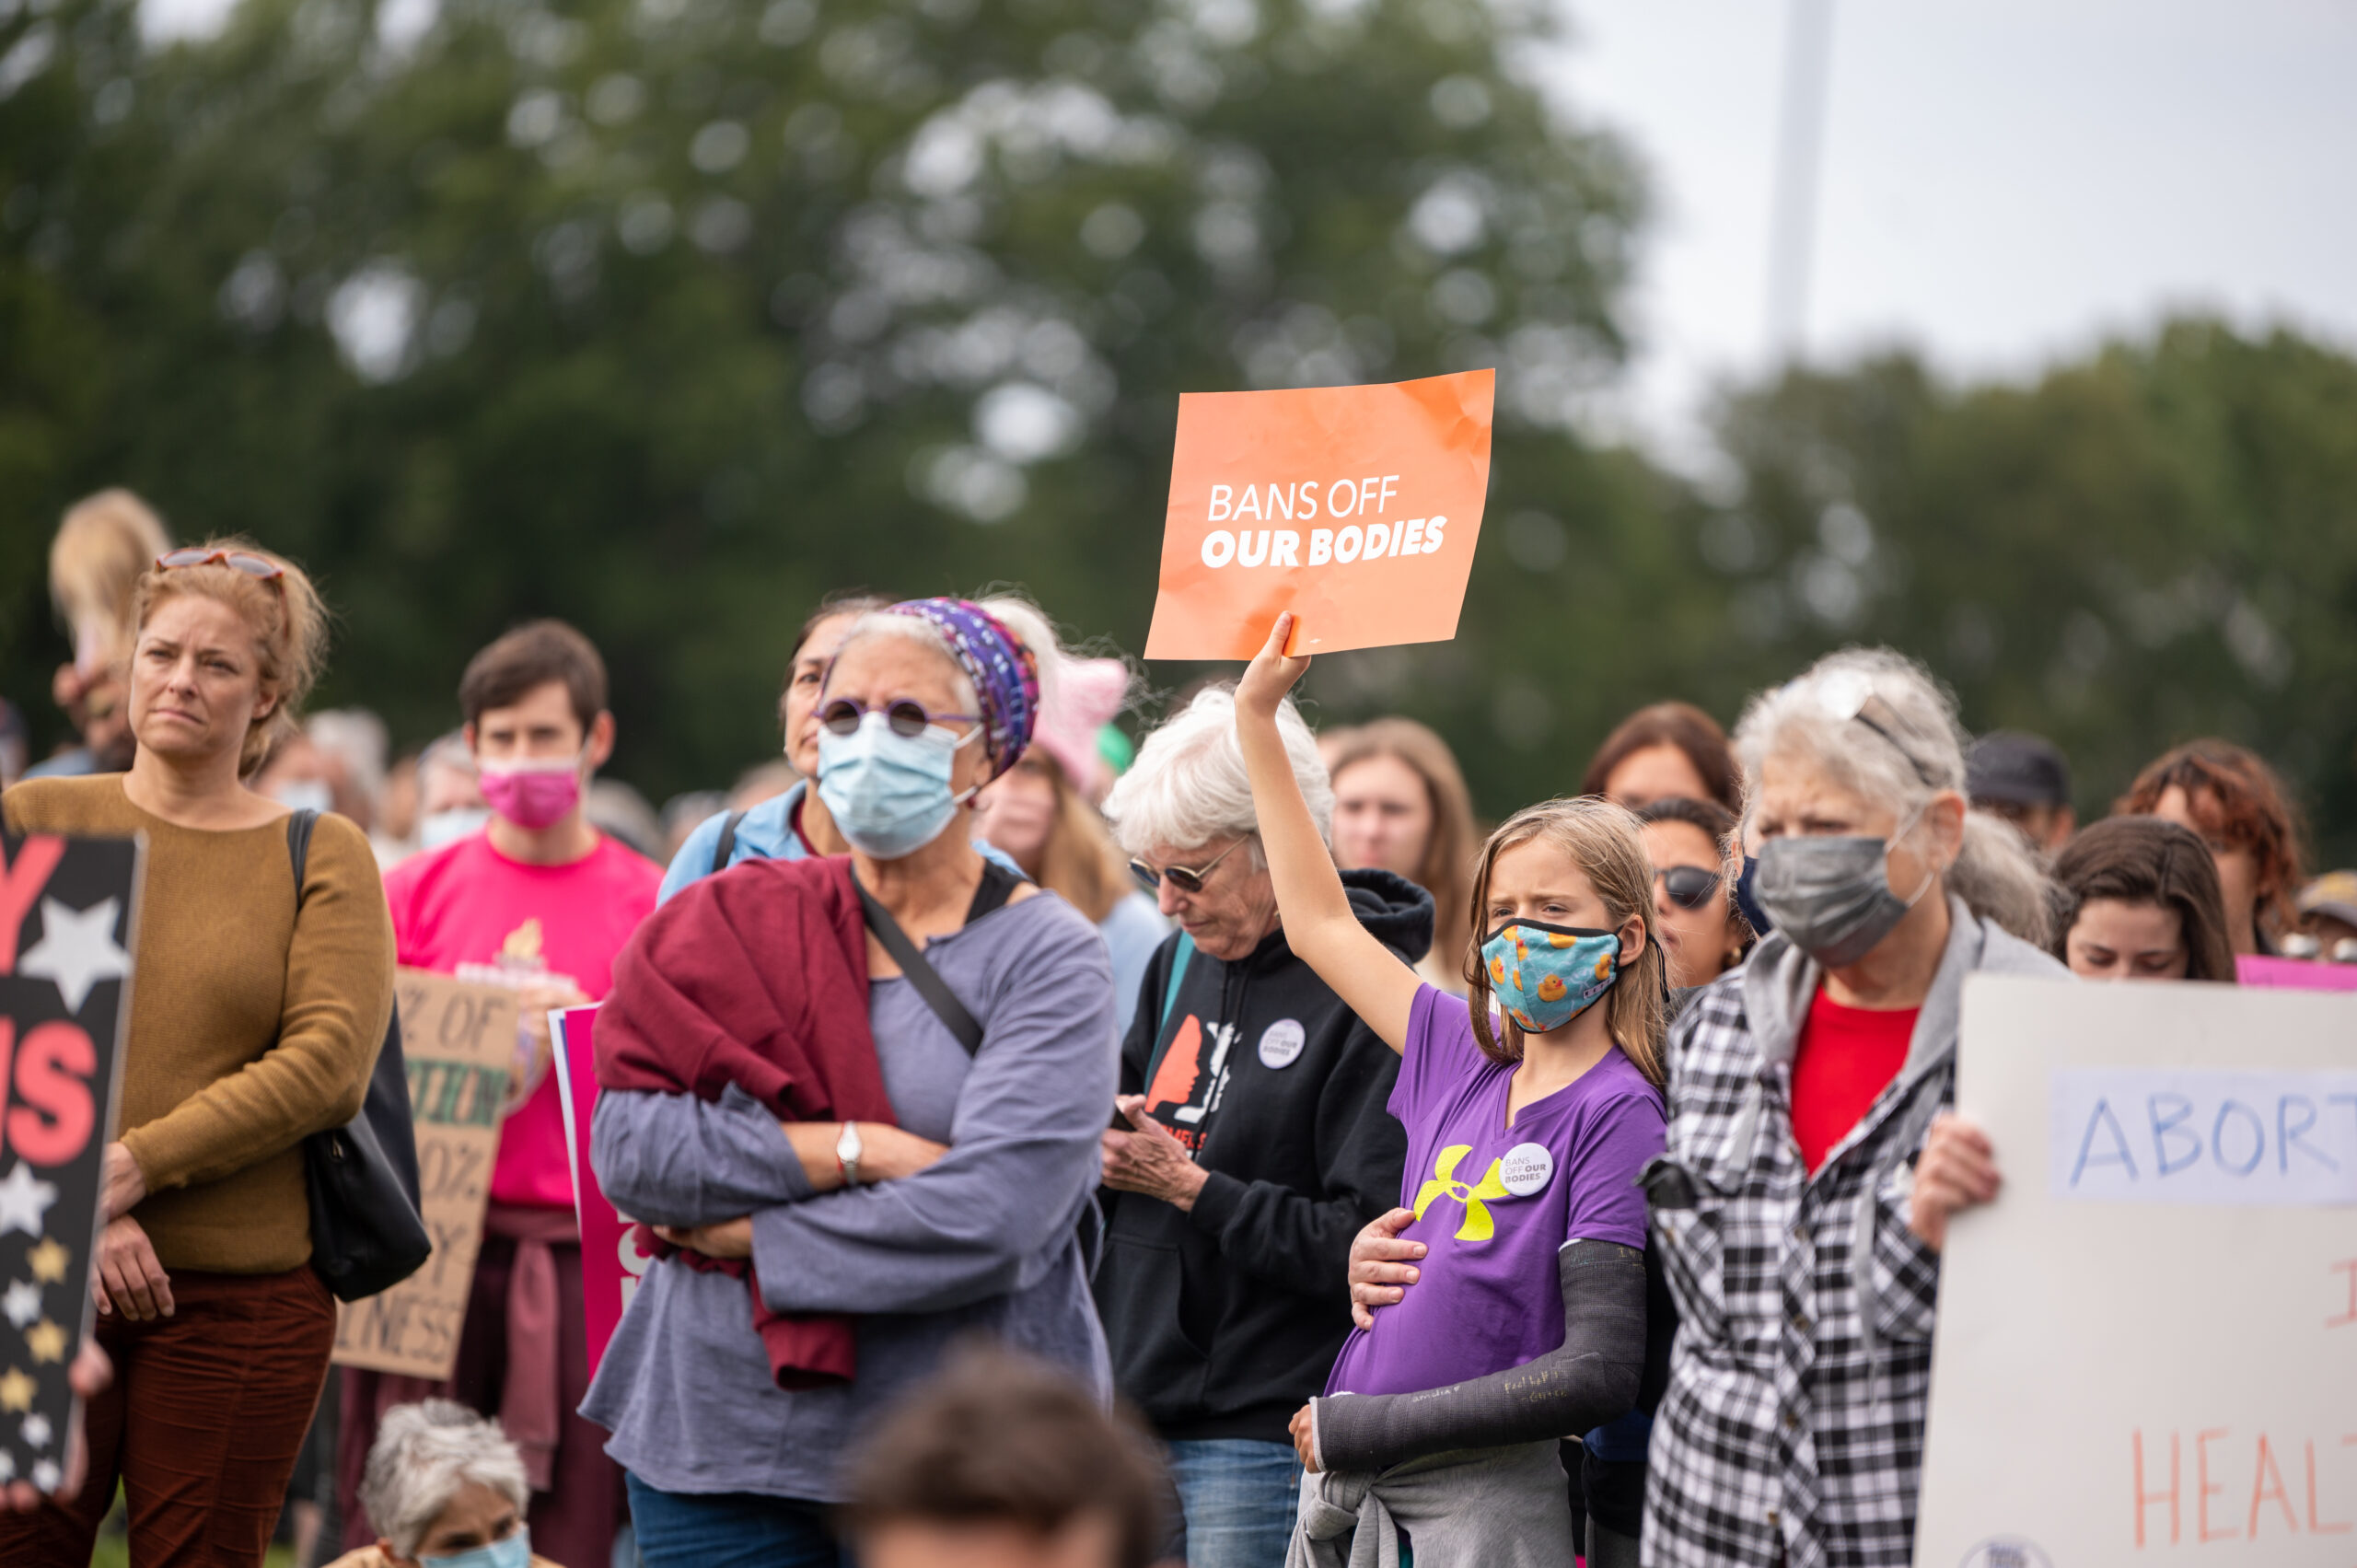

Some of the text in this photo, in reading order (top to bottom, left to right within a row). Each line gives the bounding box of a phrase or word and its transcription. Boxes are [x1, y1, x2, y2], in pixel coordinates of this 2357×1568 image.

[1207, 475, 1399, 521] BANS OFF
[1201, 516, 1447, 568] OUR BODIES
[437, 992, 507, 1052] OF
[1504, 1164, 1547, 1176] OFF OUR
[1505, 1156, 1530, 1167] BANS
[1504, 1173, 1541, 1184] BODIES
